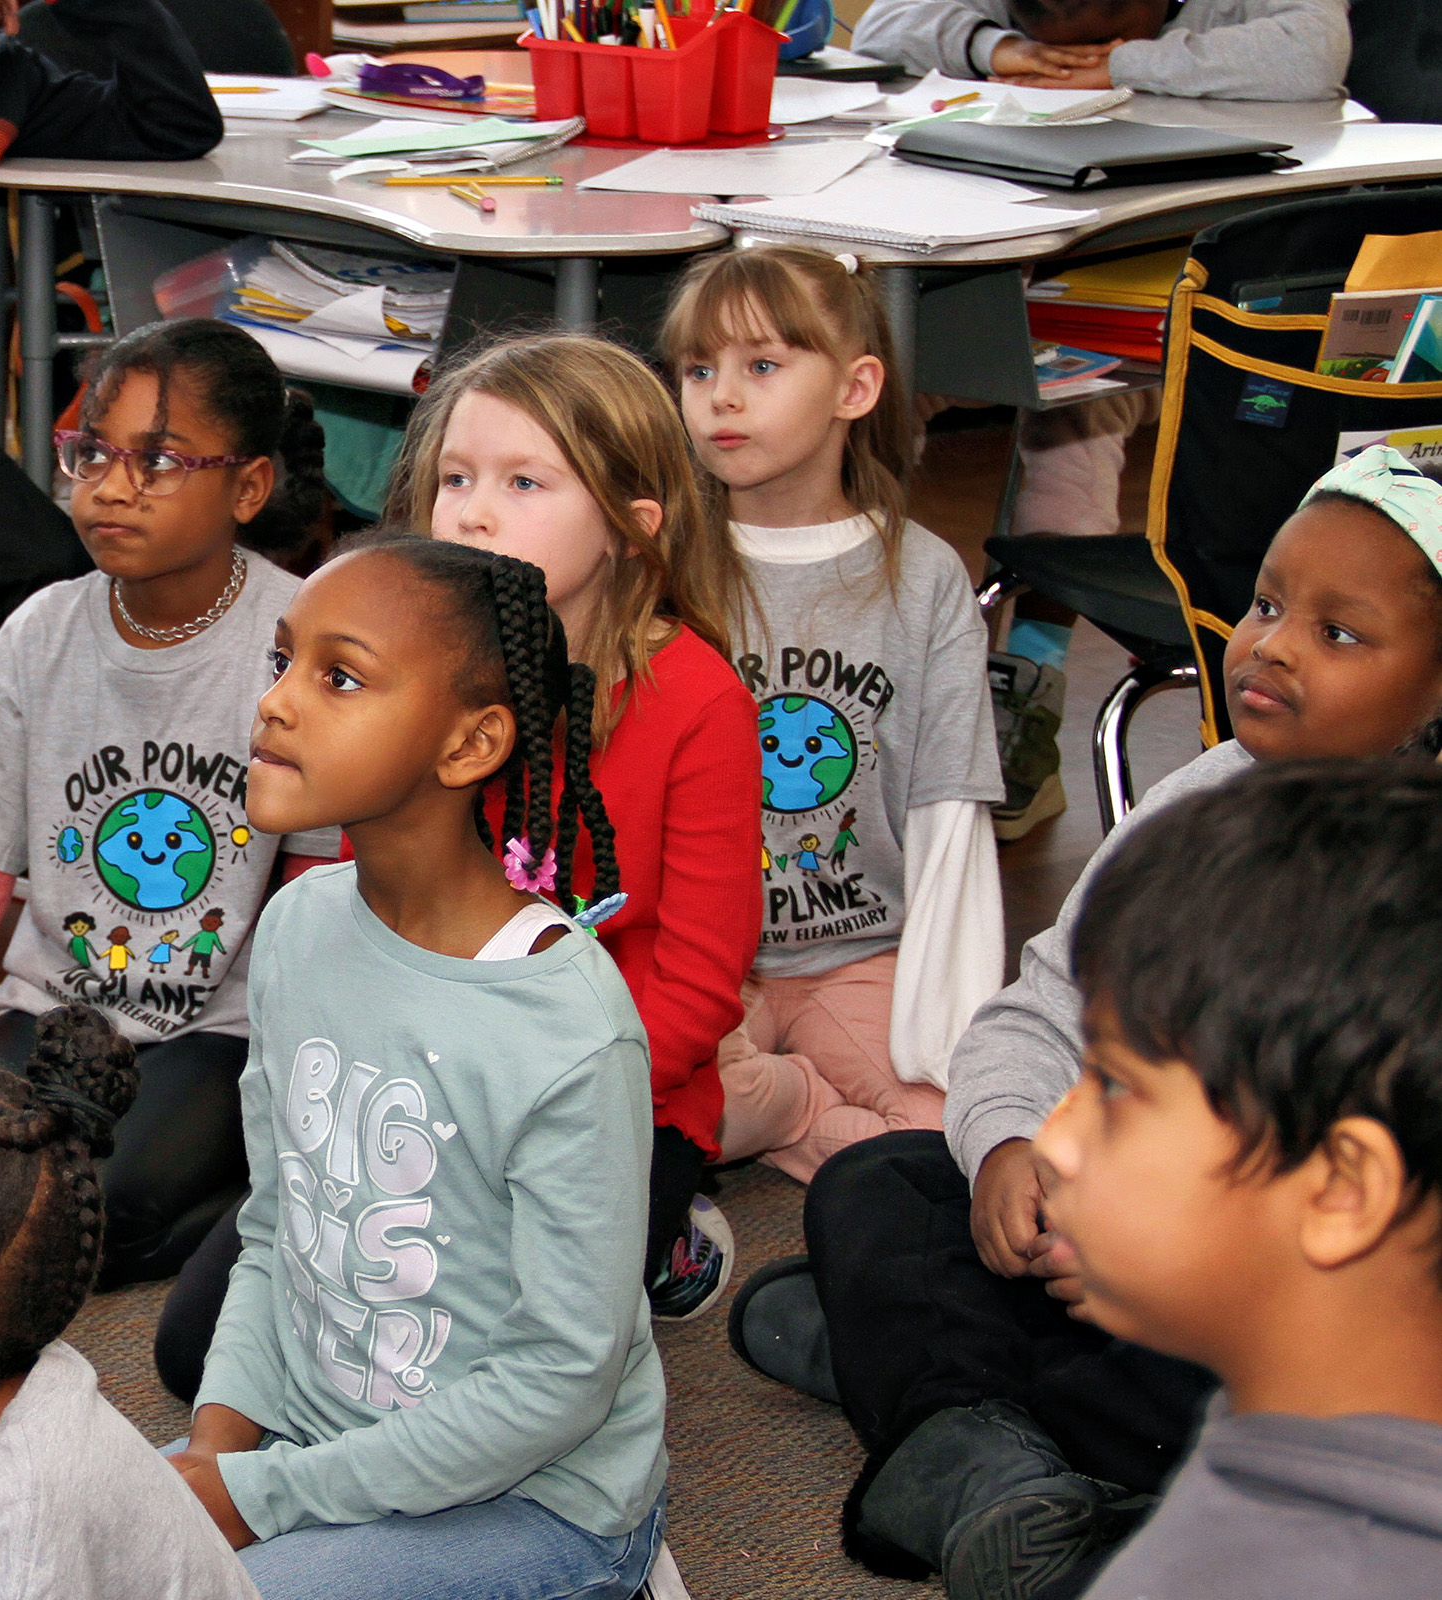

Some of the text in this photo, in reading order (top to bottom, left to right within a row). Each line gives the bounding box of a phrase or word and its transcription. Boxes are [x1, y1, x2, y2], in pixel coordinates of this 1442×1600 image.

[781, 646, 894, 725] POWER
[65, 745, 131, 811] OUR
[795, 906, 889, 941] ELEMENTARY
[286, 1036, 437, 1196] BIG
